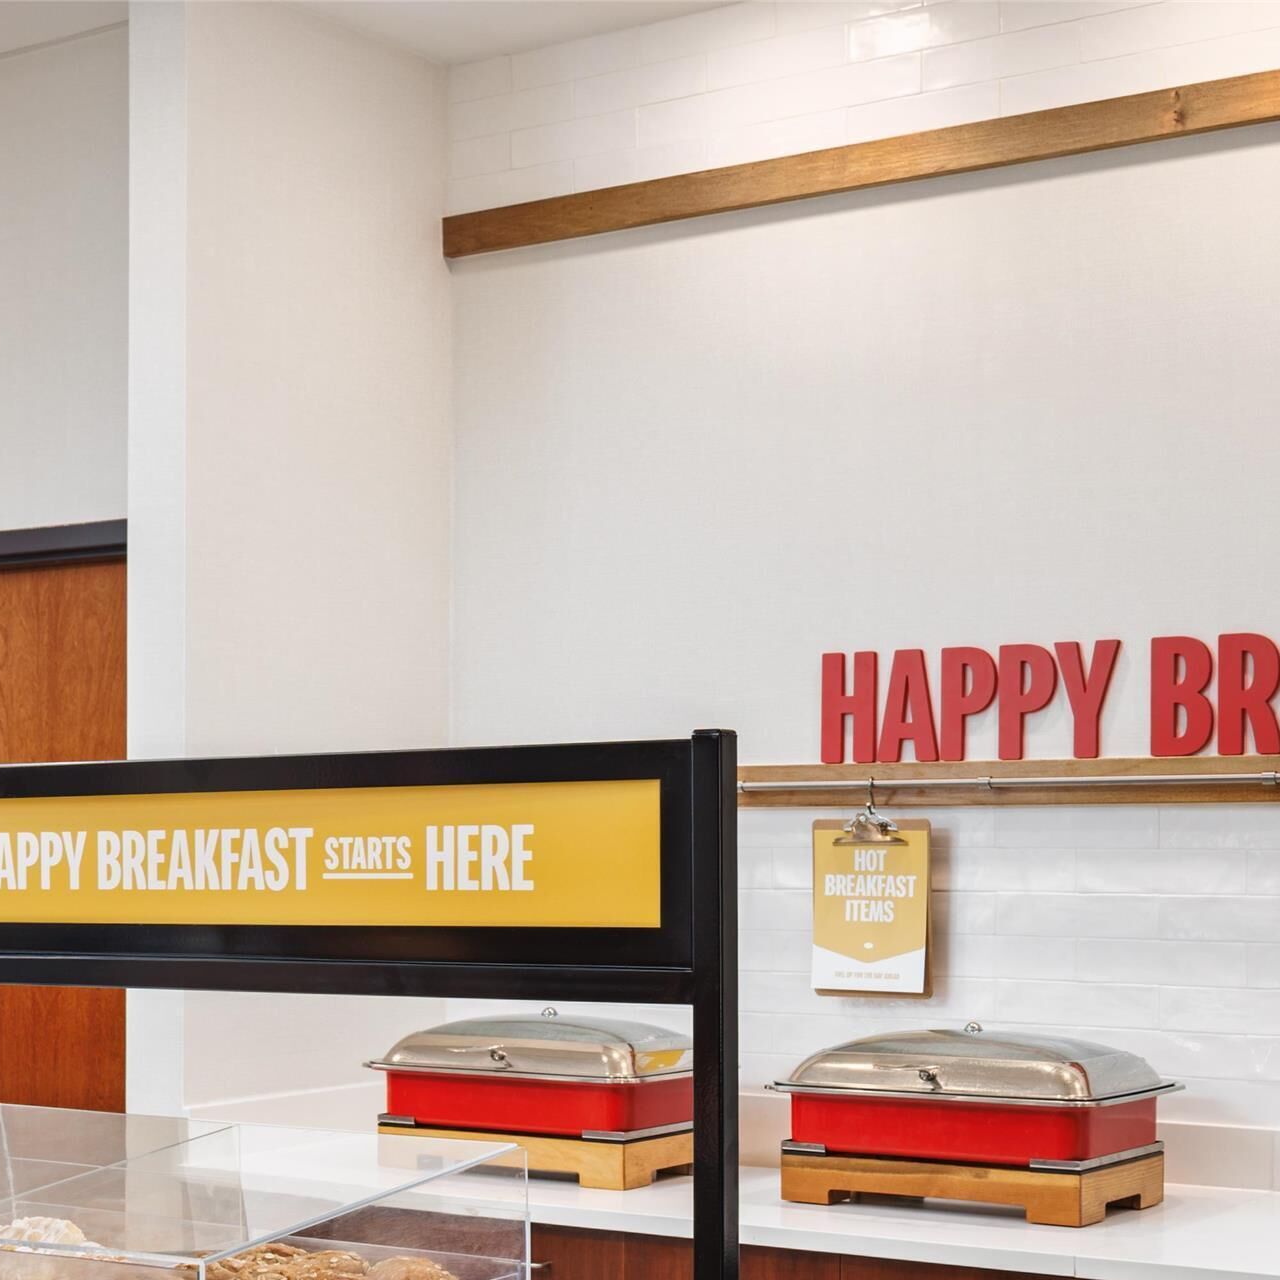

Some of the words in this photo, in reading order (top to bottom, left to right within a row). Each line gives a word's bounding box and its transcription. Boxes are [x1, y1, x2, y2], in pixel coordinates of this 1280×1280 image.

[820, 640, 1120, 763] HAPPY
[98, 828, 314, 891] BREAKFAST
[323, 835, 414, 871] STARTS
[425, 823, 534, 891] HERE
[853, 849, 888, 872] HOT
[823, 873, 918, 898] BREAKFAST
[844, 898, 895, 922] ITEMS
